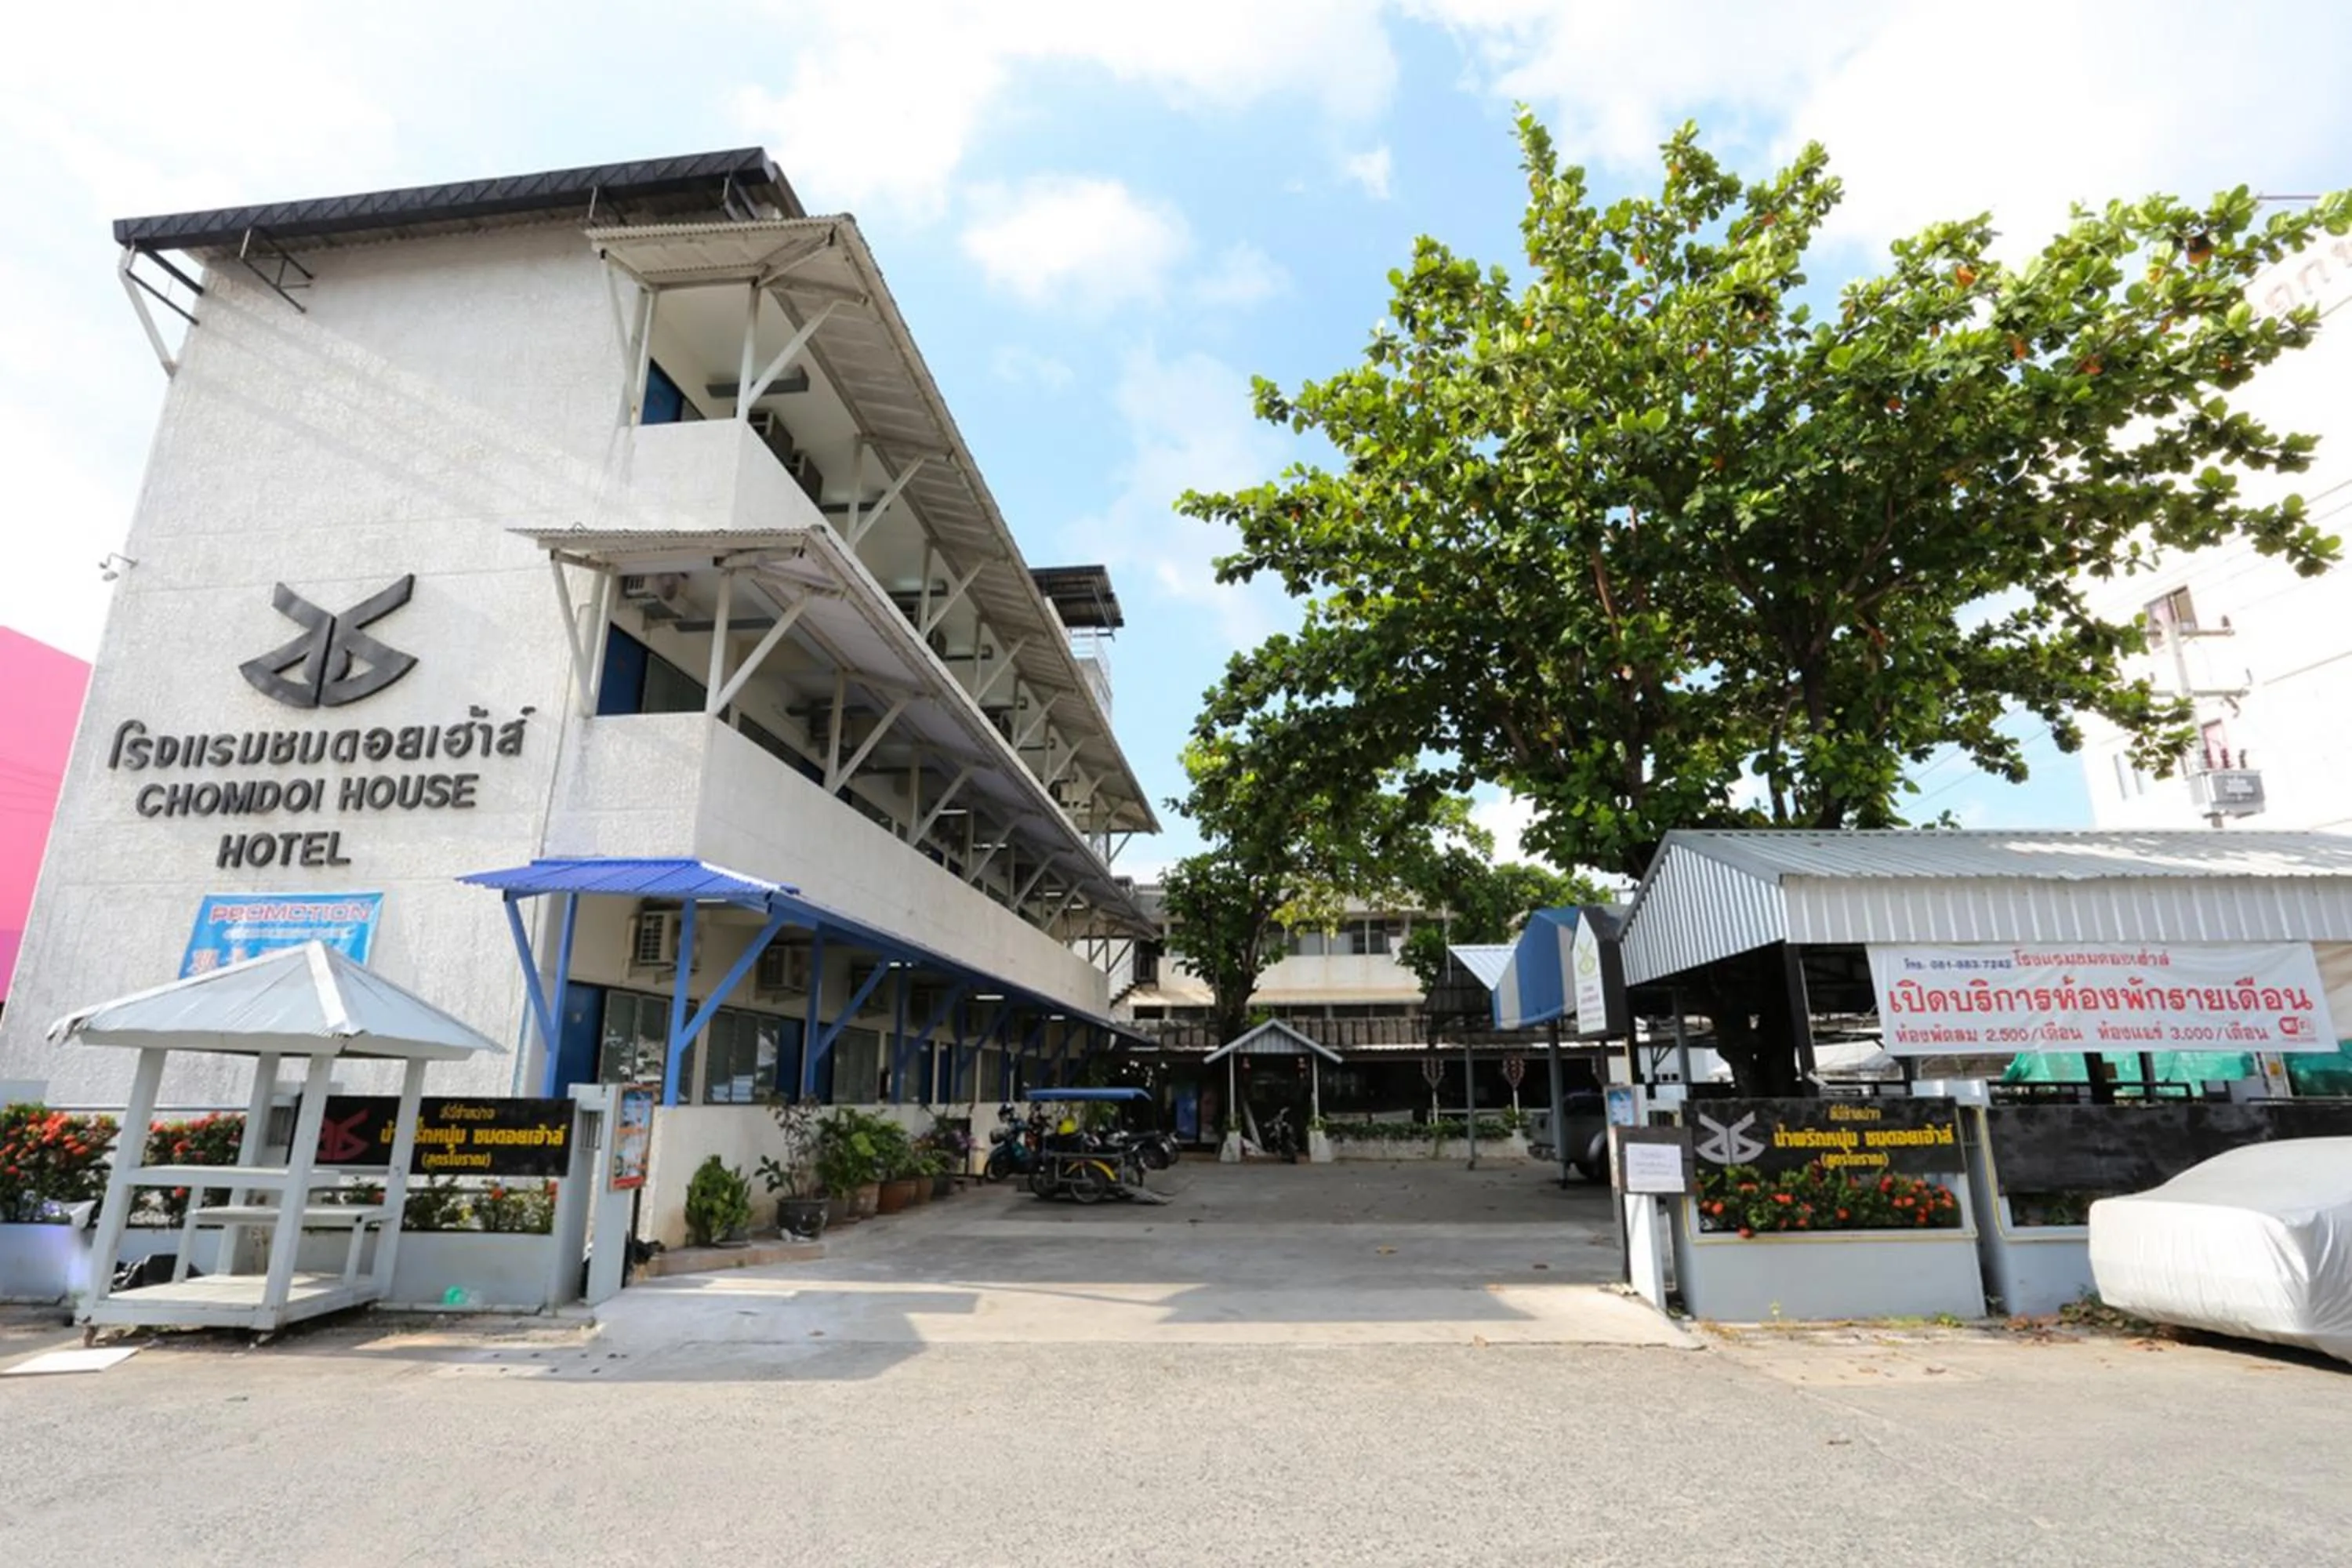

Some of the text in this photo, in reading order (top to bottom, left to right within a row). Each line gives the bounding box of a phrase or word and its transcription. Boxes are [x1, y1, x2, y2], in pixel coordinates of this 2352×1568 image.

[107, 706, 536, 770] โรงแรมชมดอยเฮ้าส์
[136, 774, 481, 818] CHOMDOI HOUSE
[216, 831, 351, 868] HOTEL
[210, 903, 373, 923] PROMOTION
[1888, 975, 2314, 1013] เปิดบริการห้องพักรายเดือน
